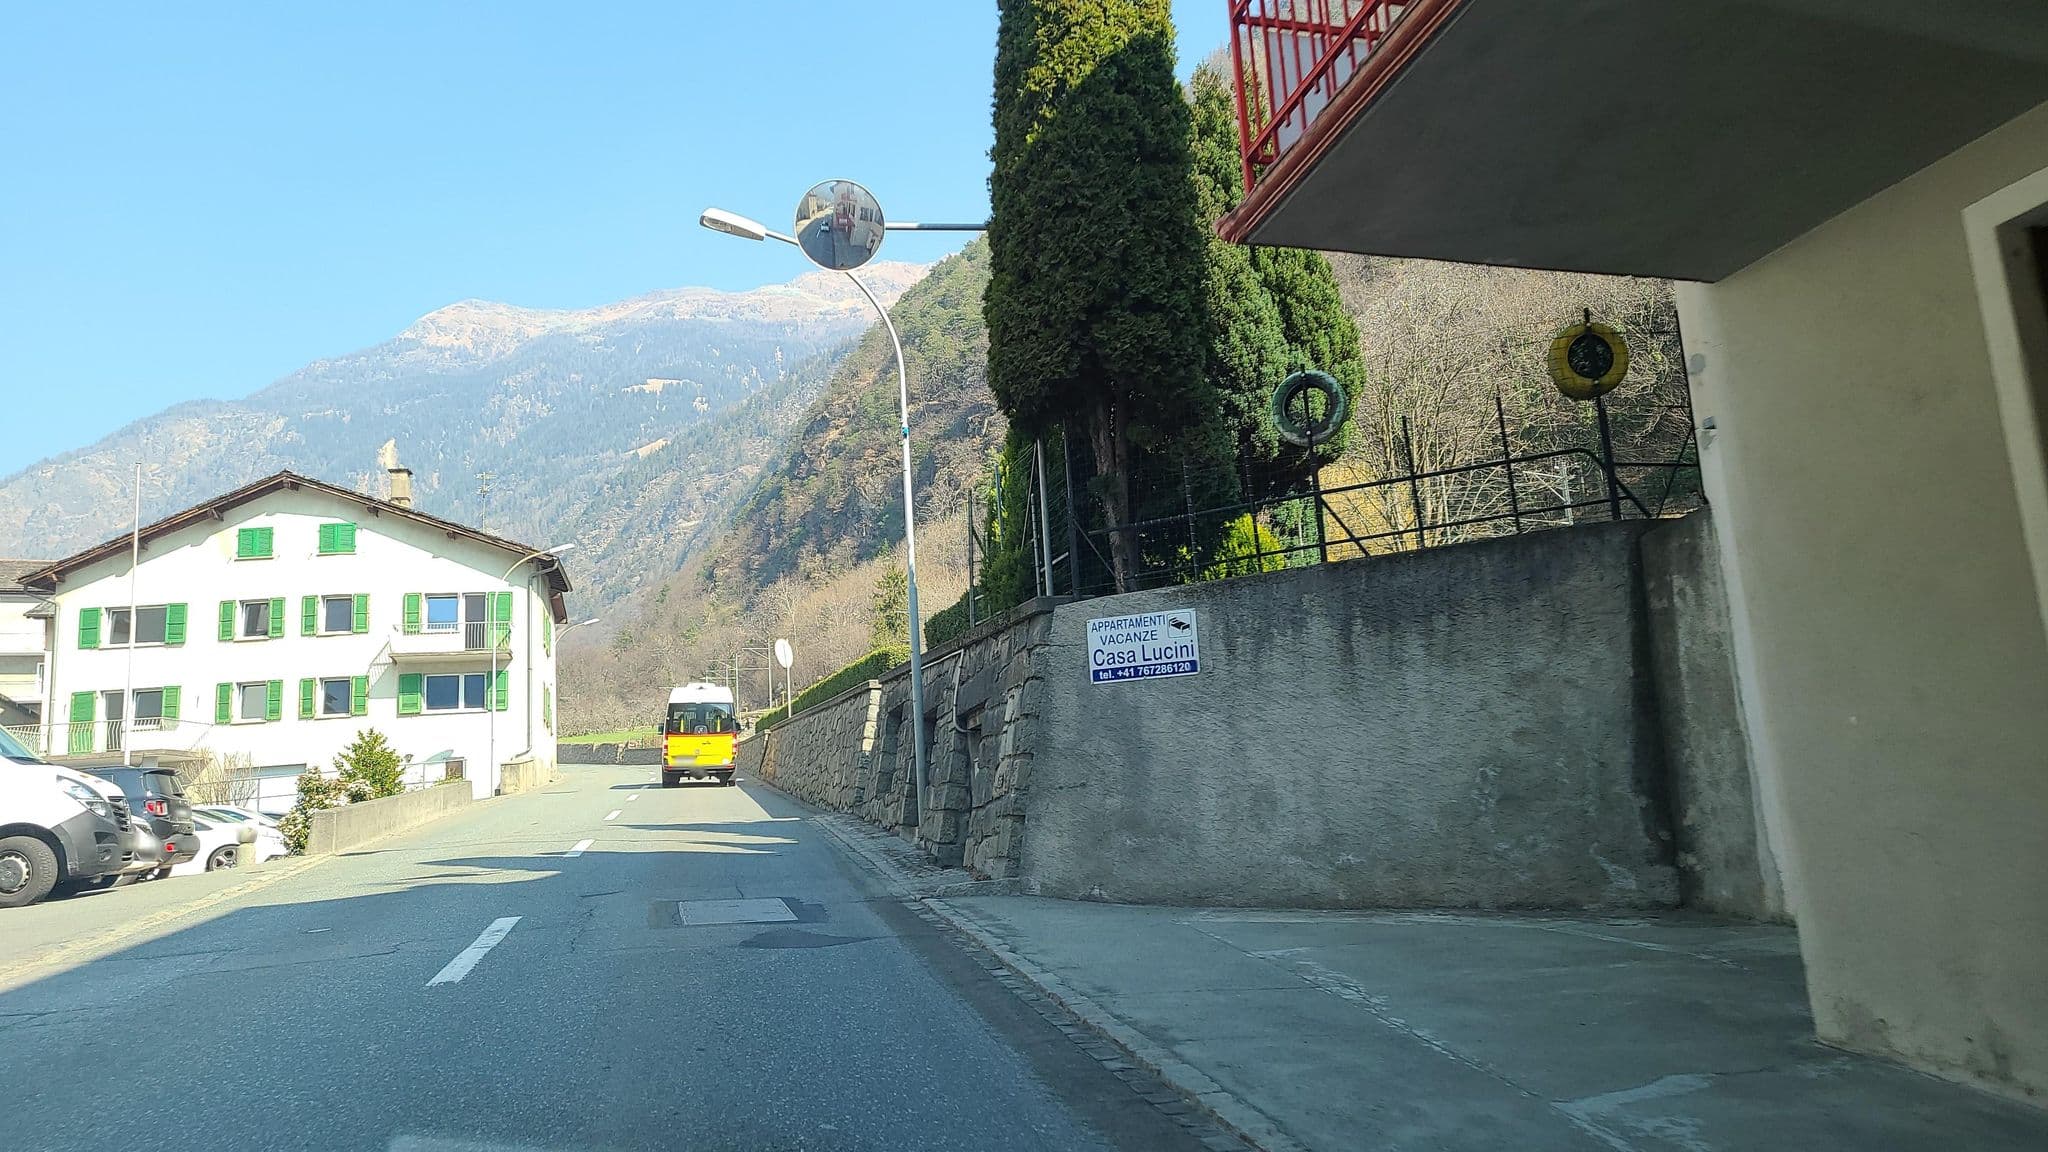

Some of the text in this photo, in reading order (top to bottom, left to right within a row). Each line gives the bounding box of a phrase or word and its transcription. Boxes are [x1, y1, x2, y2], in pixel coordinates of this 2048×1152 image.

[1091, 614, 1166, 633] APPARTAMENTI
[1100, 629, 1158, 646] VACANZE
[1093, 640, 1195, 666] Casa Lucini
[1099, 662, 1191, 680] tel. +41 767286120
